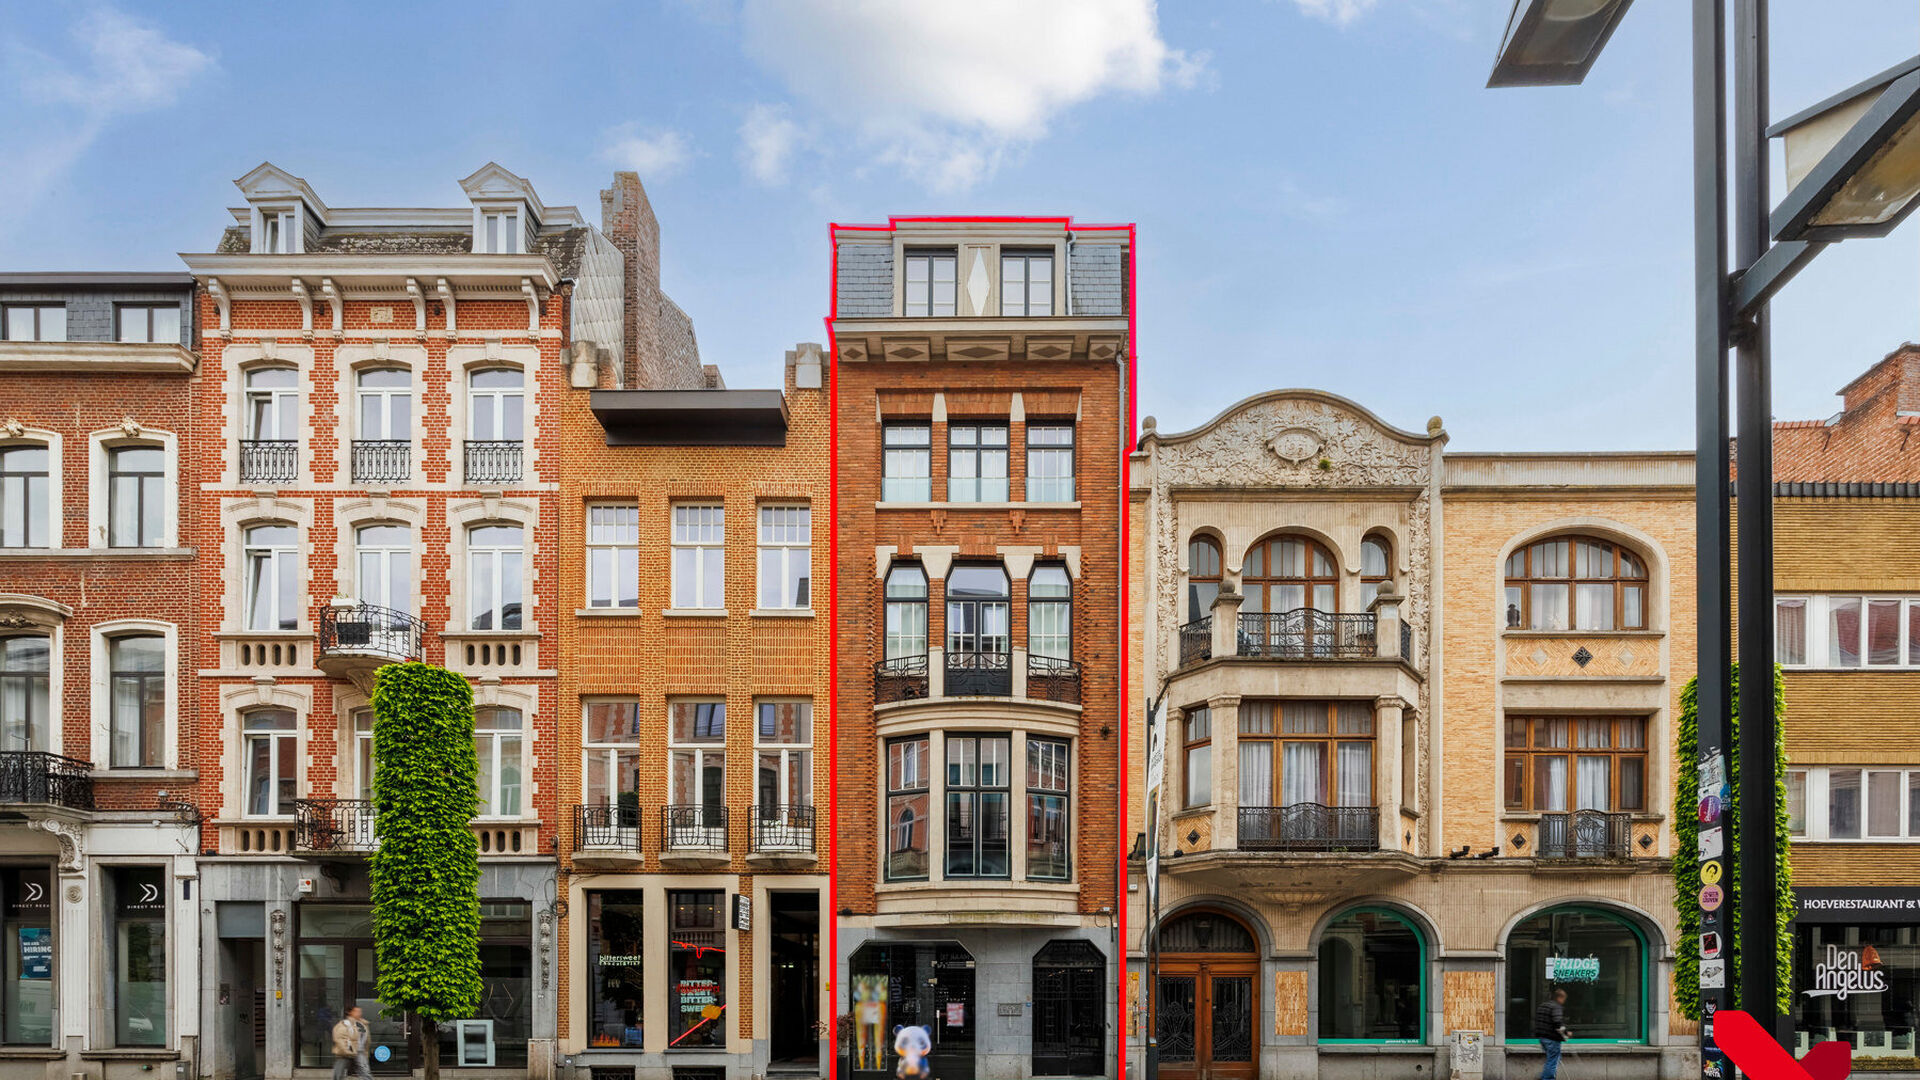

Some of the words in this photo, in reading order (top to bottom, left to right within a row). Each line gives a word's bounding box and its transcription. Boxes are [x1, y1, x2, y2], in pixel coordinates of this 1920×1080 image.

[1804, 899, 1905, 909] HOEVERESTAURANT
[1906, 900, 1915, 909] &
[1554, 958, 1598, 969] FRIDGE
[1827, 944, 1858, 970] Den
[1815, 963, 1884, 1001] Angelus
